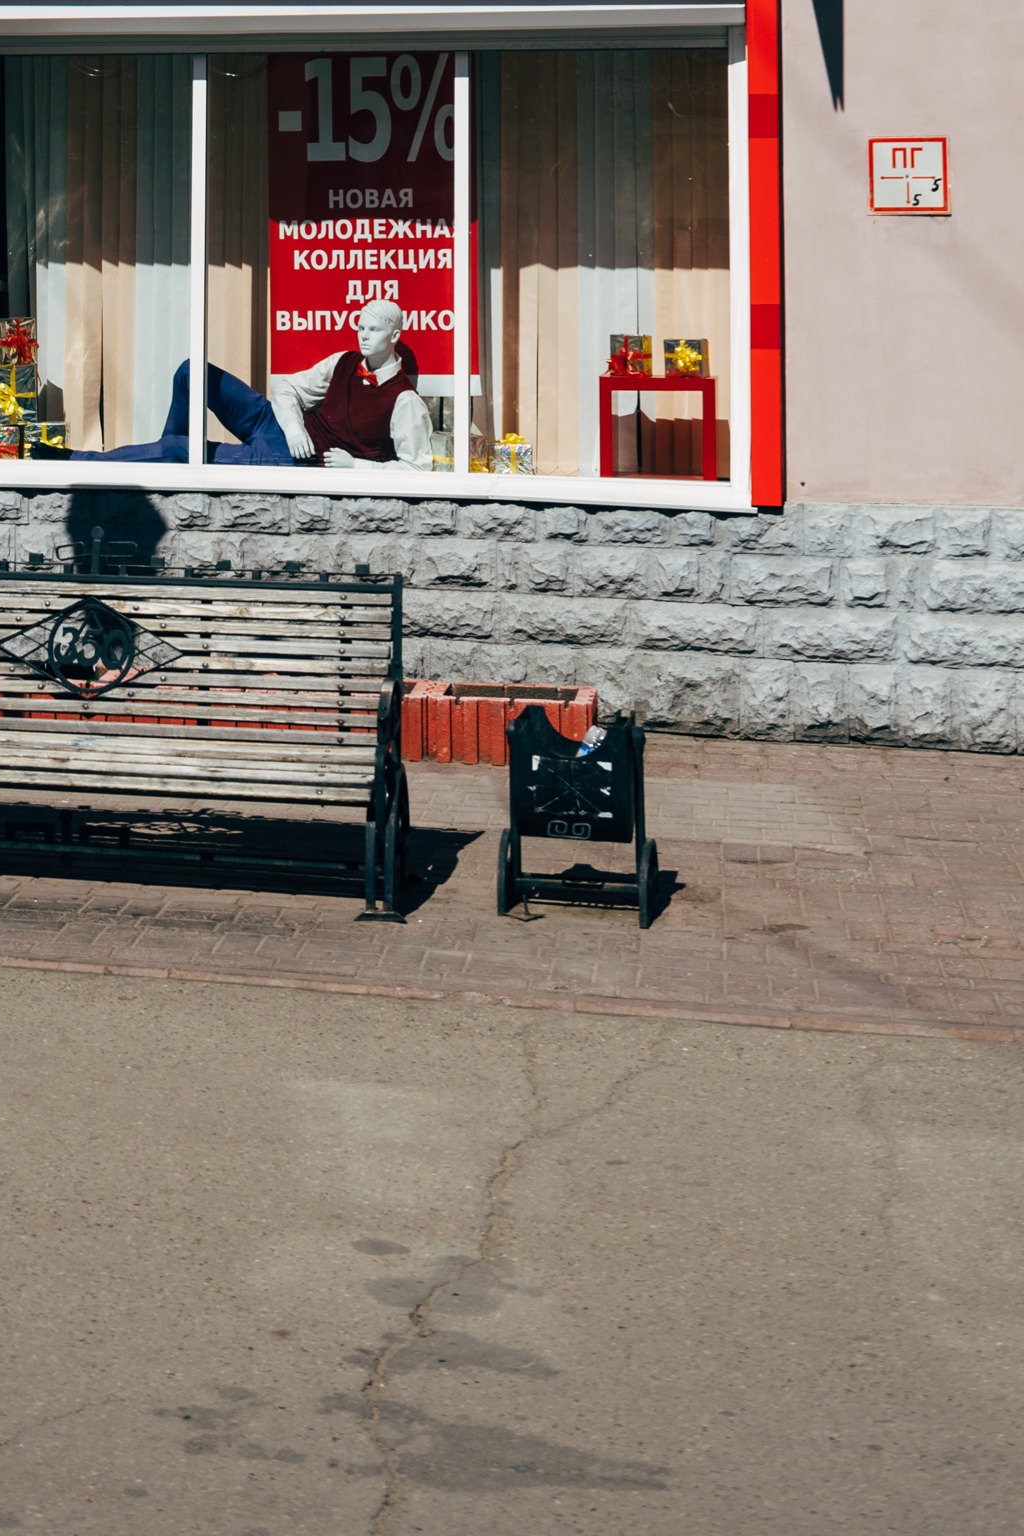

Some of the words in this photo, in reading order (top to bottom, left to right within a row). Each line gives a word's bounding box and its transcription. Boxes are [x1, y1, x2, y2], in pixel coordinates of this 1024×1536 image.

[278, 52, 455, 163] -15%
[892, 147, 923, 169] ПГ
[931, 178, 942, 192] 5
[329, 188, 414, 208] НОВАЯ
[912, 193, 922, 206] 5
[279, 218, 455, 242] МОЛОДЕЖНА
[294, 248, 453, 273] КОЛЛЕКЦИЯ
[345, 280, 399, 304] ДЛЯ
[276, 310, 455, 331] ВЫПУСИКО
